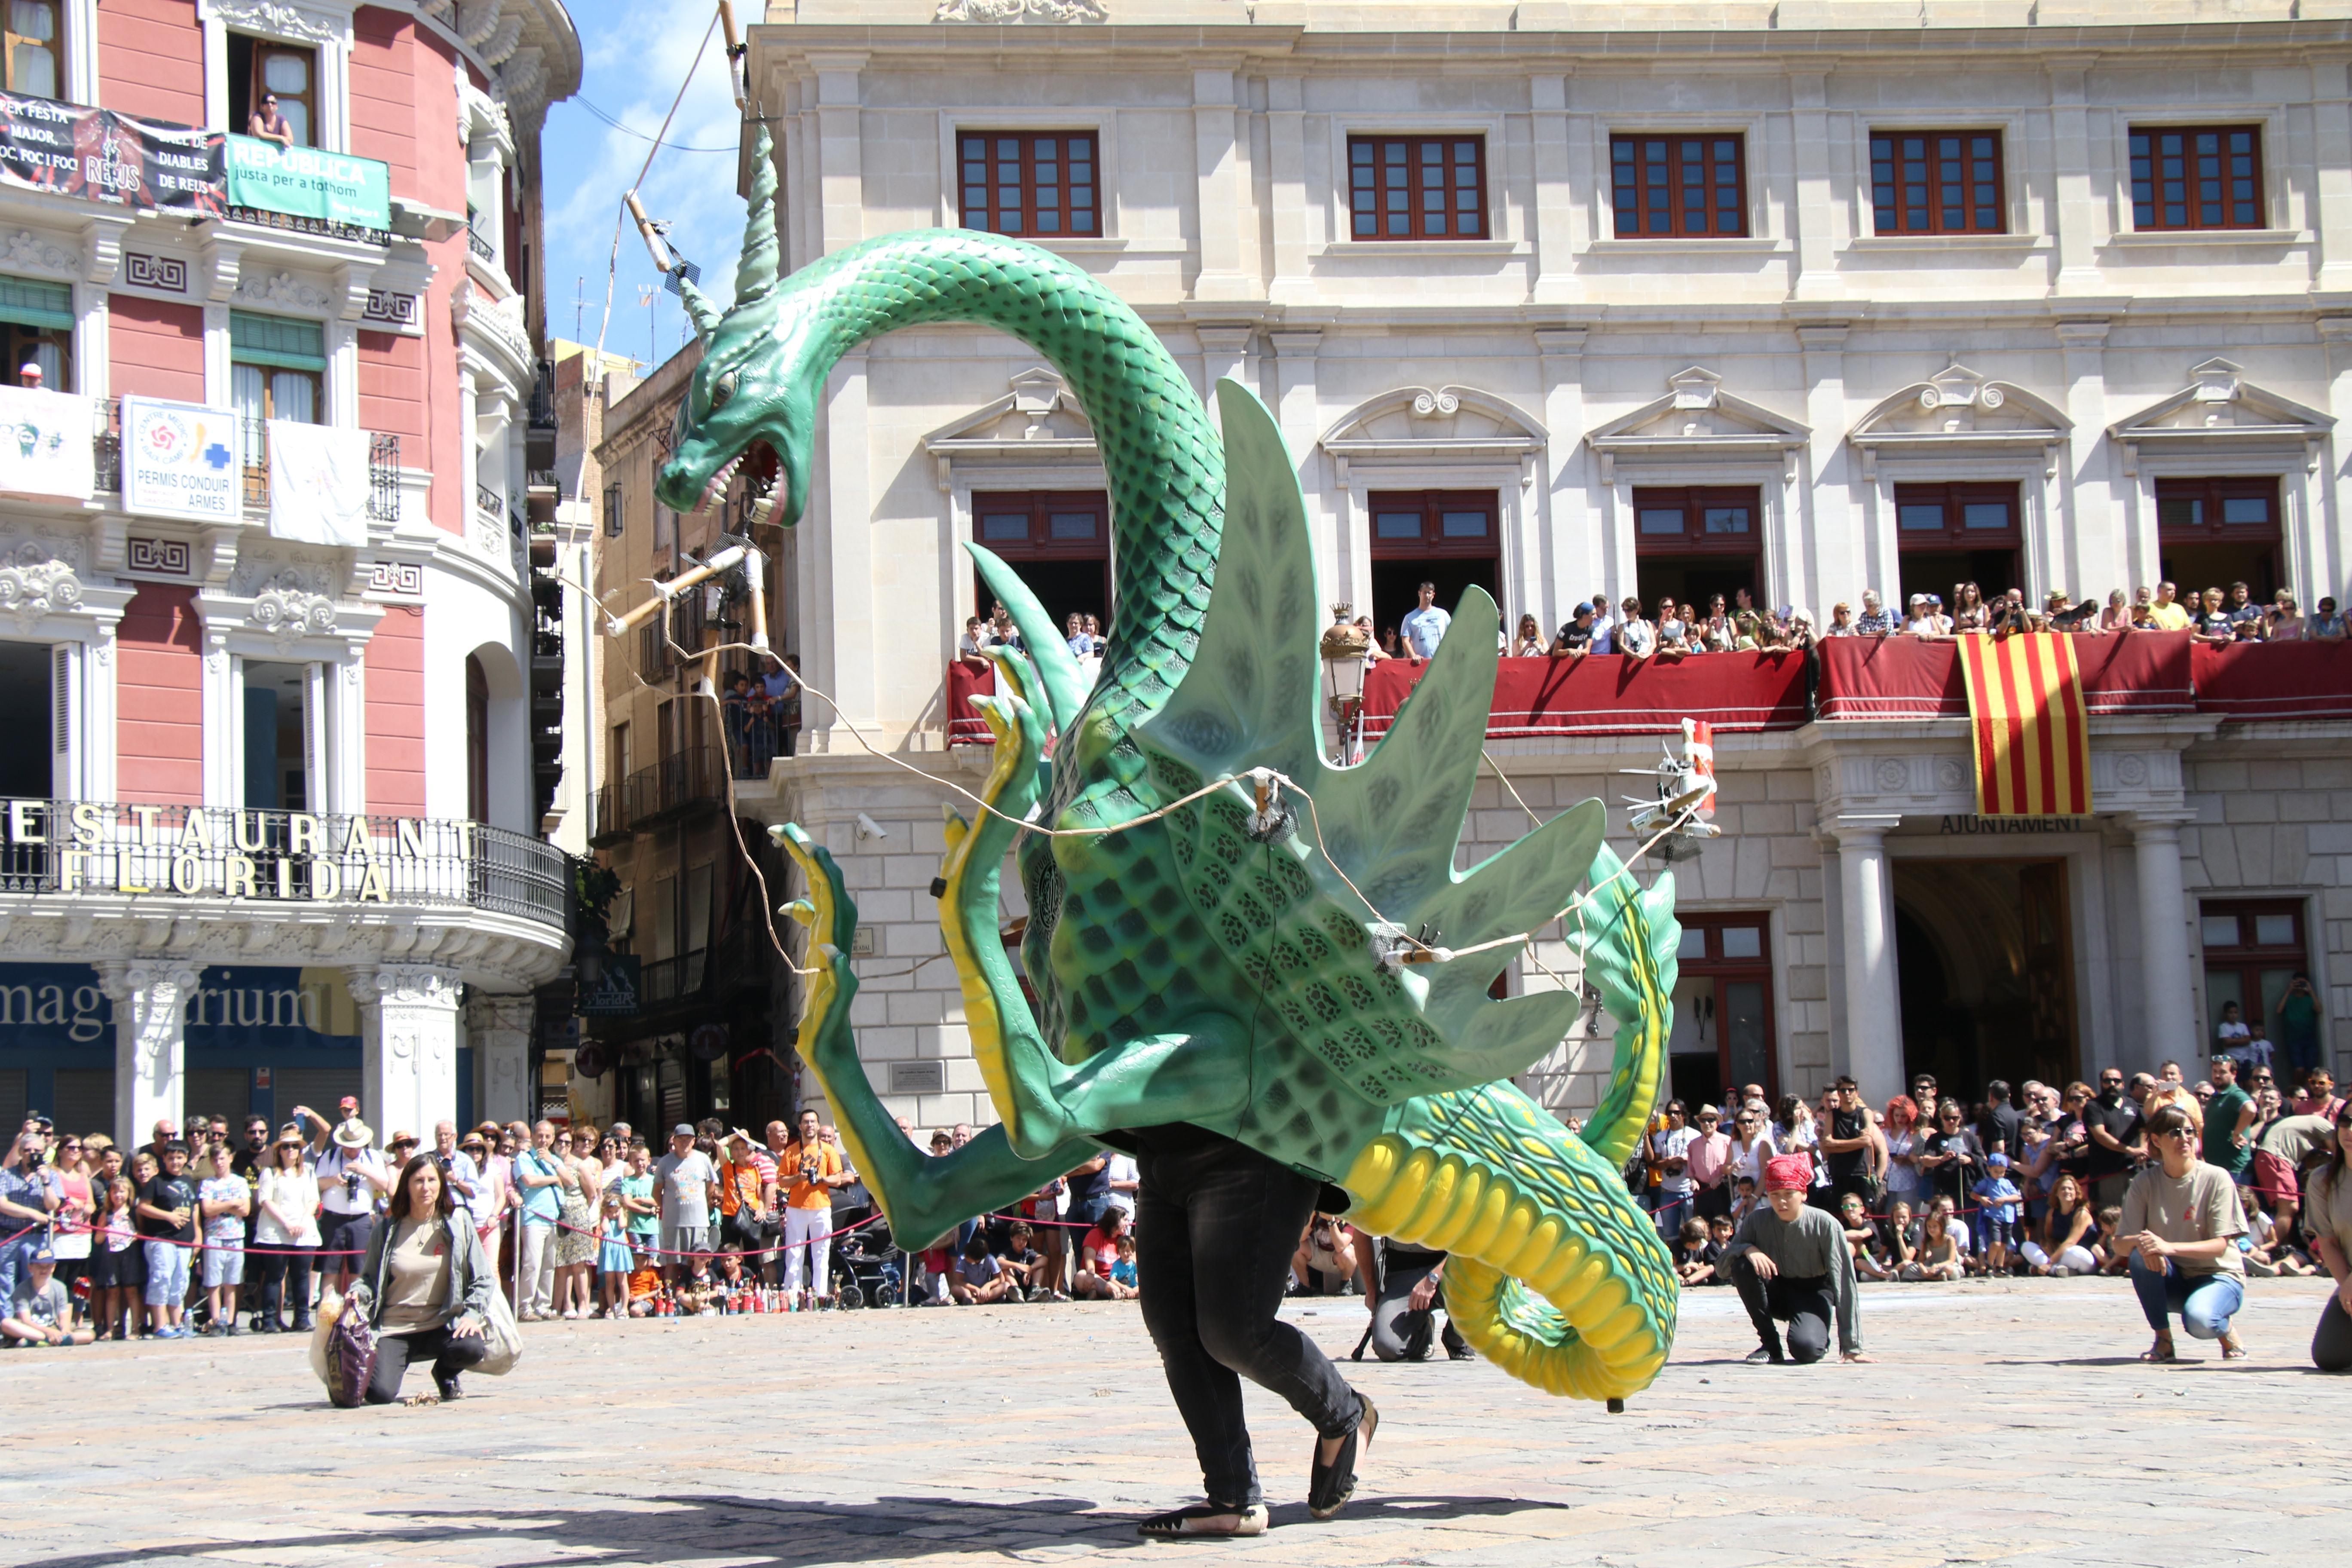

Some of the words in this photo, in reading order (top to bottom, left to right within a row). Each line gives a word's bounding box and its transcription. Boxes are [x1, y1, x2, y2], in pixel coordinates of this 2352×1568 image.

[27, 104, 68, 124] FESTA
[10, 124, 58, 146] MAJOR,
[193, 134, 208, 150] DE
[20, 148, 43, 165] FOC
[46, 153, 50, 166] I
[159, 151, 208, 171] DIABLES
[159, 173, 175, 189] DE
[178, 177, 208, 194] REUS
[235, 166, 268, 181] justa
[273, 175, 294, 187] per
[300, 178, 306, 188] a
[312, 179, 357, 198] tothom
[138, 411, 165, 434] CENTRE
[141, 445, 159, 463] BAIX
[162, 449, 184, 464] CAMP
[181, 475, 230, 493] CONDUIR
[188, 493, 226, 511] ARMES
[1941, 815, 2082, 834] AJUNTAMENT
[59, 849, 389, 902] FLORIDA
